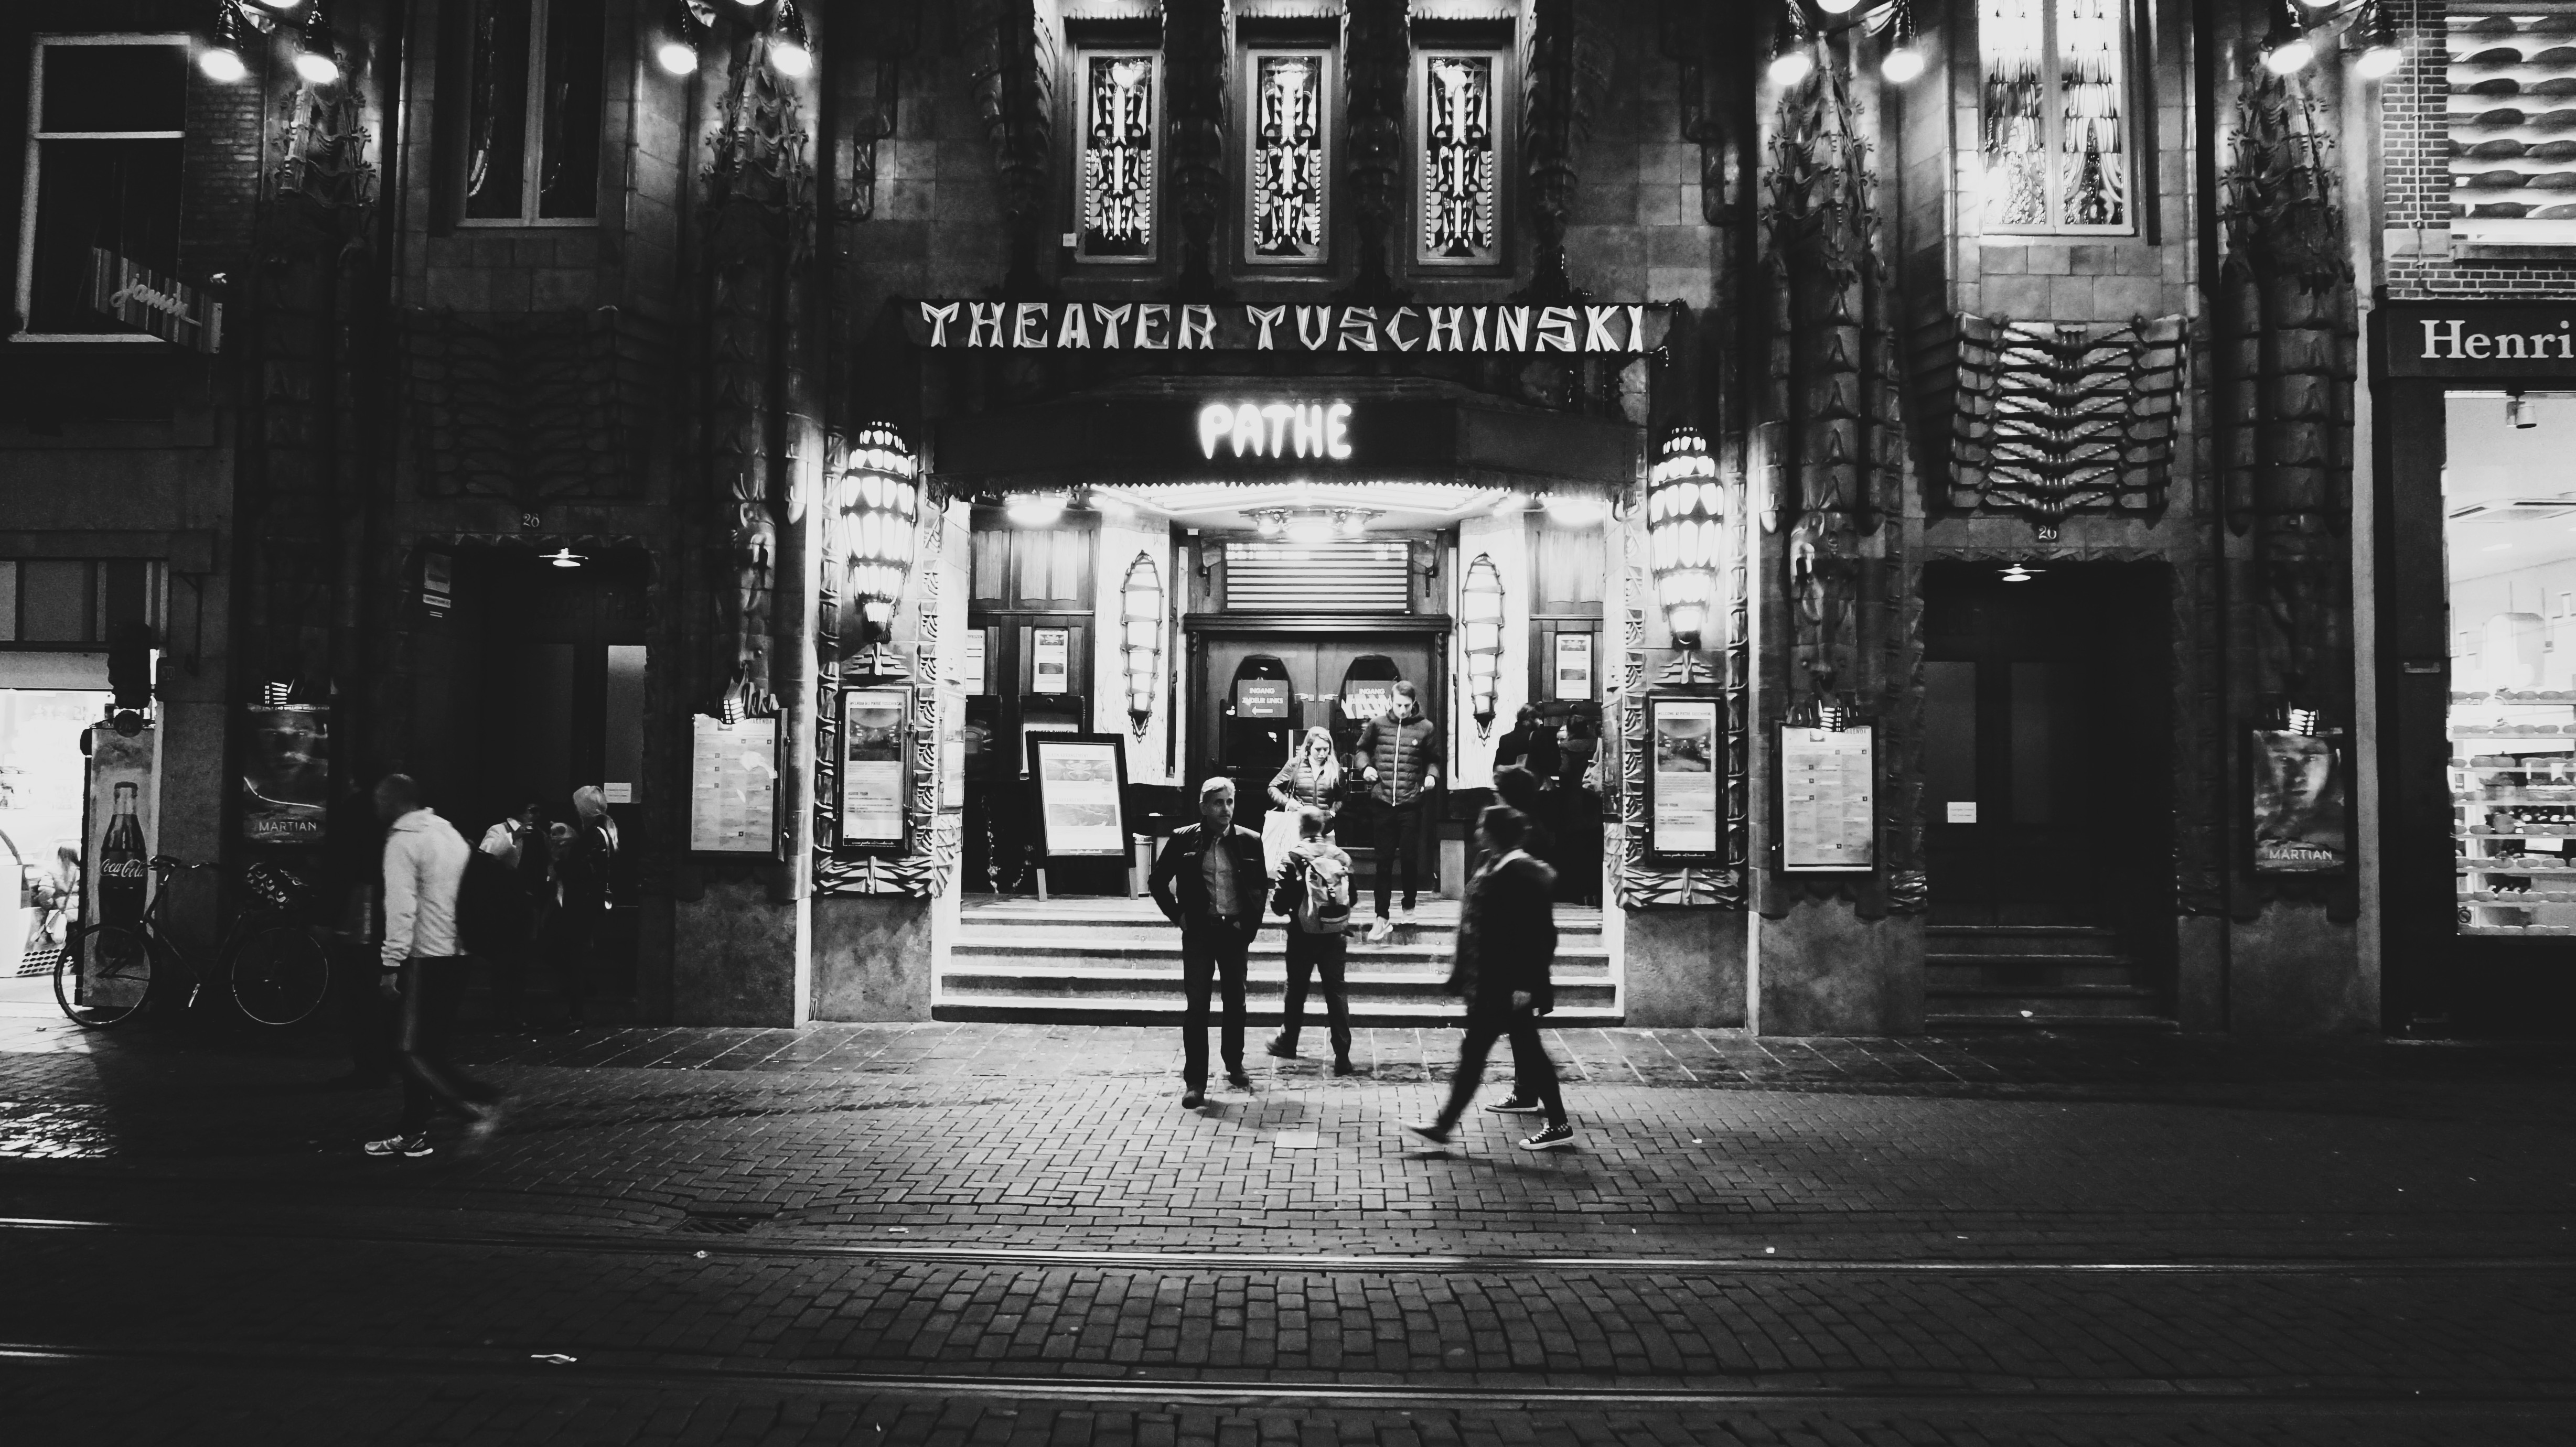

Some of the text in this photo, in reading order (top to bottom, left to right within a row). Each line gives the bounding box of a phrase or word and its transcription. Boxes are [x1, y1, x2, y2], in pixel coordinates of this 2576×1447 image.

[920, 302, 1643, 352] THEATER TUSCHINSKI
[2420, 320, 2574, 359] Henri
[1200, 404, 1351, 459] PATHE
[523, 513, 540, 527] 28
[259, 822, 316, 832] MARTIAN
[2269, 849, 2333, 860] MARTIAN
